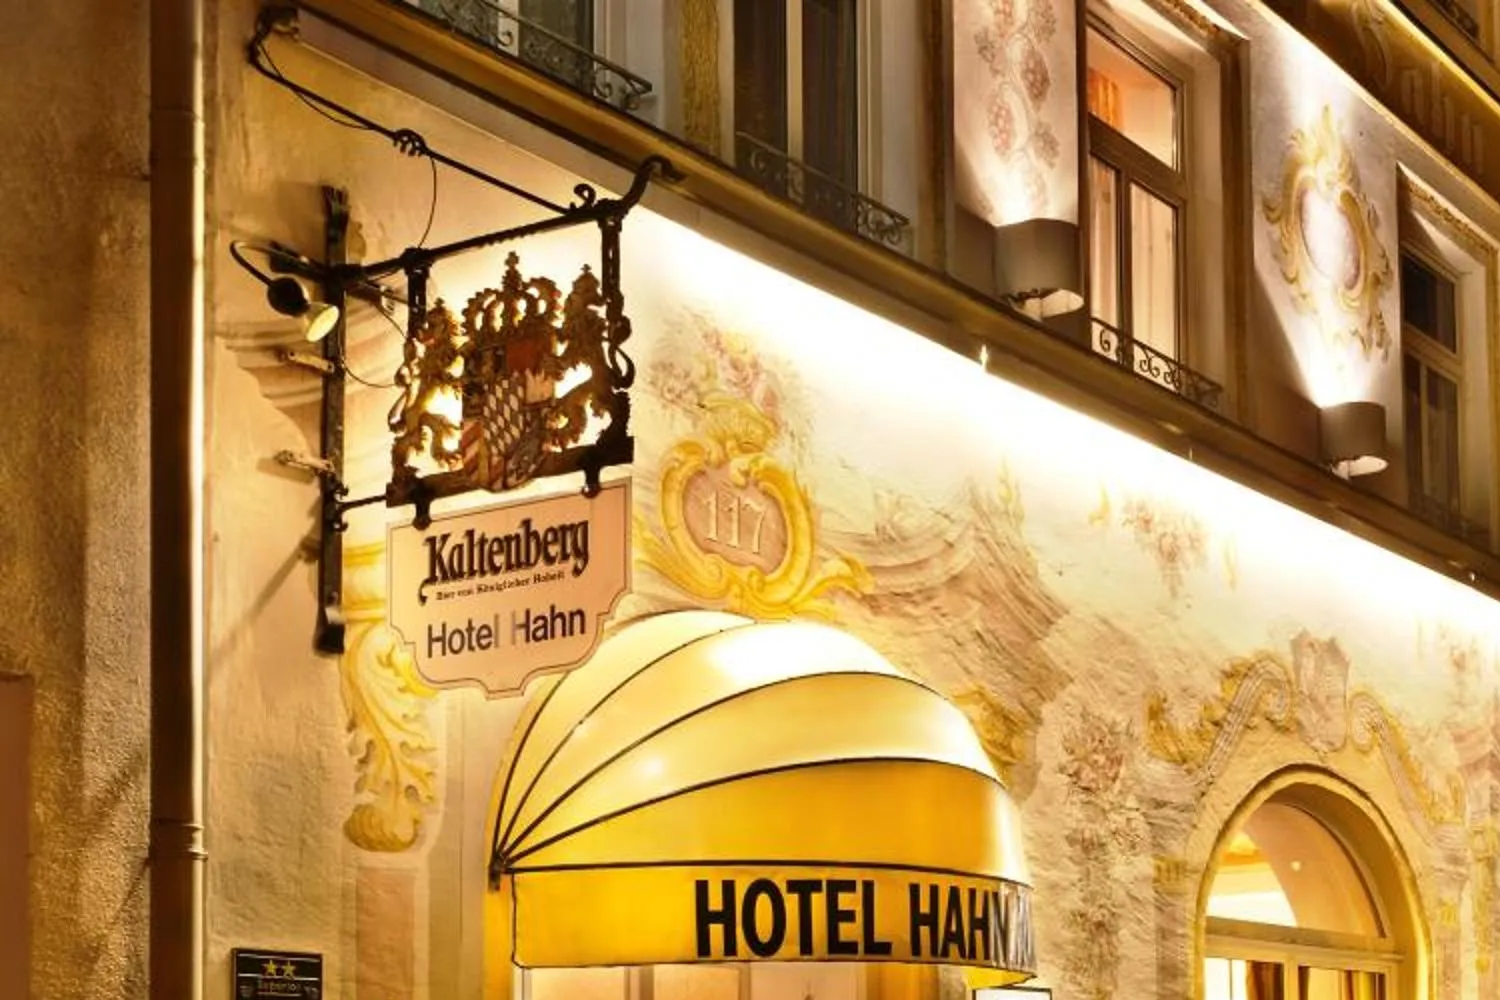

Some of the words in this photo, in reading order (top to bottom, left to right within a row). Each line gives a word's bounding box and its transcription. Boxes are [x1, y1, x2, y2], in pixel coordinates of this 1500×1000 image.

[703, 491, 767, 555] 117
[418, 518, 589, 605] Kaltenberg
[427, 612, 499, 659] Hotel
[511, 603, 587, 646] Hahn
[694, 878, 893, 958] HOTEL
[908, 882, 1009, 969] HAHN
